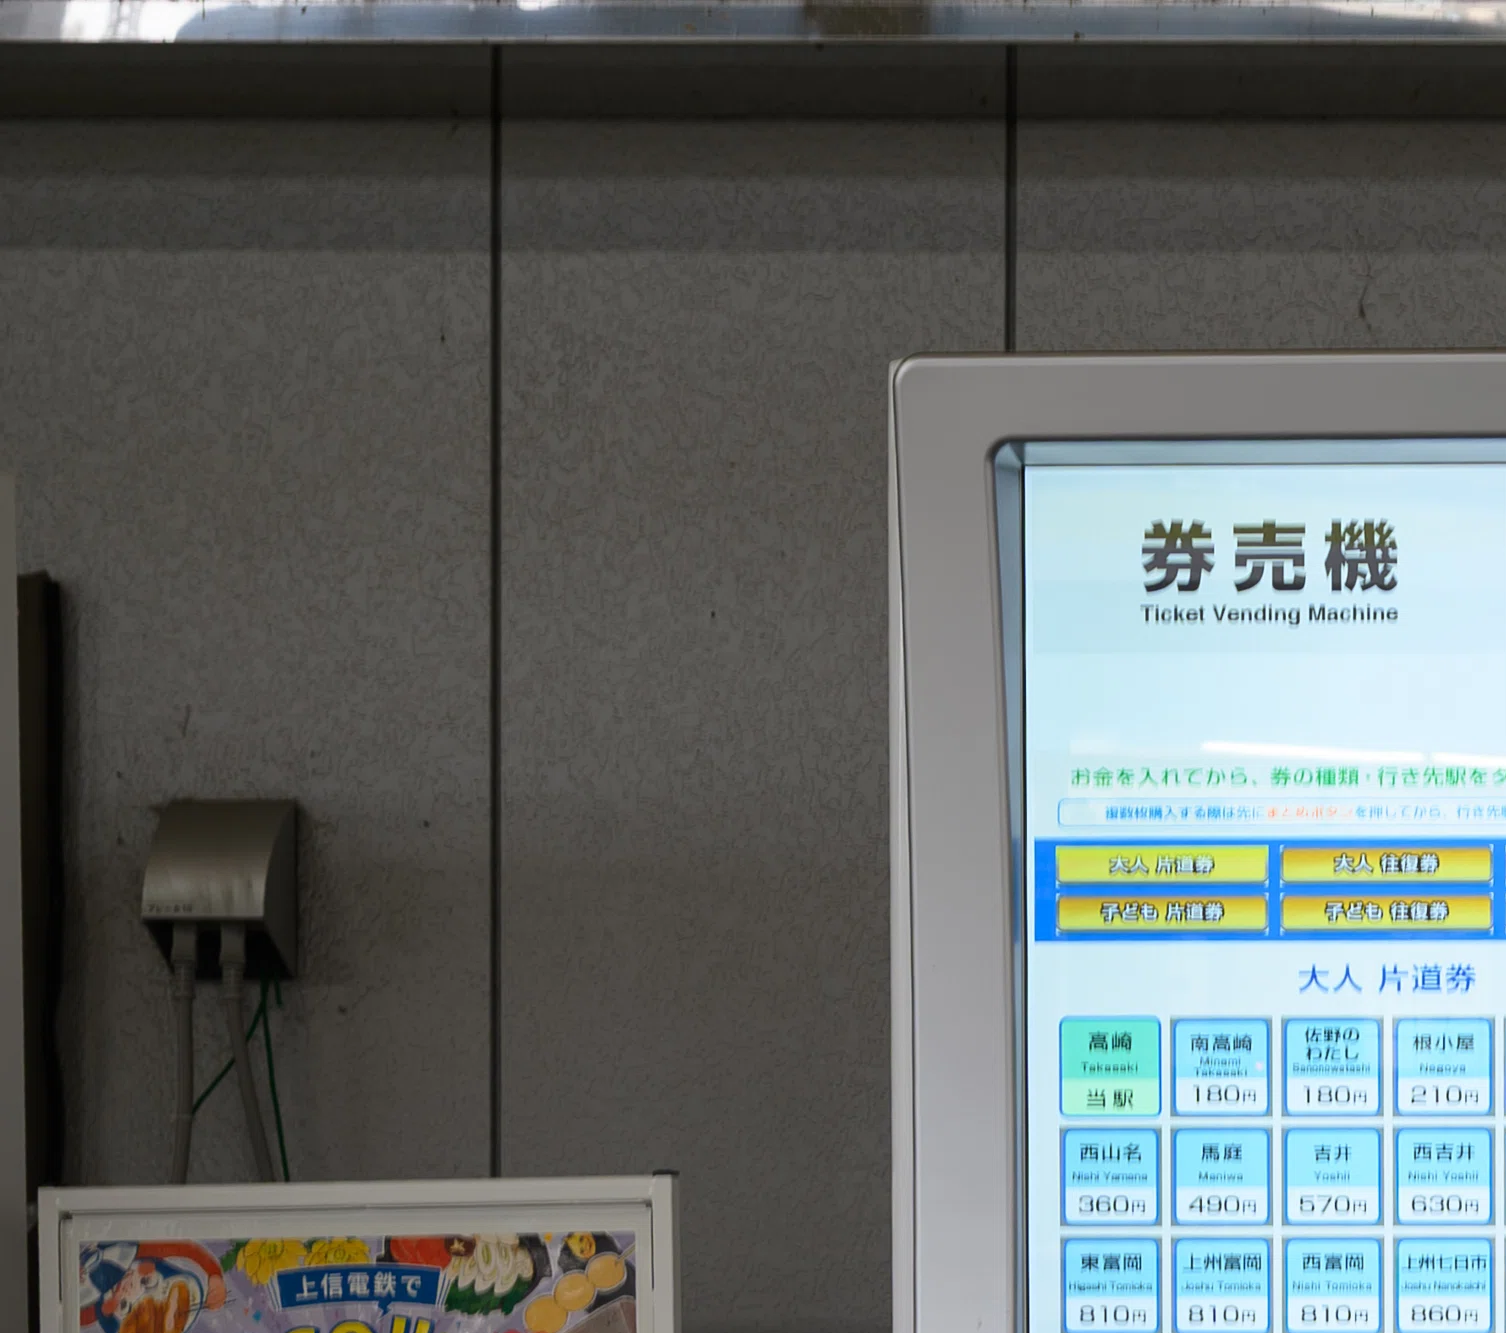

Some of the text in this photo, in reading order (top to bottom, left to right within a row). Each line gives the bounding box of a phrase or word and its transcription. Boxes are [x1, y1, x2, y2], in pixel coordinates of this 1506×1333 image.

[1141, 518, 1399, 593] 券売機
[1140, 604, 1399, 628] Ticket Vending Machine
[1109, 855, 1215, 875] 大人 片道券
[1334, 854, 1440, 875] 大人 往復券
[1100, 902, 1225, 923] 子ども 片道券
[1325, 902, 1449, 923] 子ども 往復券
[1299, 963, 1477, 994] 大人 片道券
[1088, 1030, 1133, 1053] 高崎
[1190, 1032, 1252, 1053] 南高崎
[1305, 1026, 1360, 1044] 佐野の
[1413, 1032, 1475, 1052] 根小屋
[1305, 1044, 1359, 1061] わたし
[1086, 1088, 1134, 1110] 当駅
[1193, 1084, 1257, 1105] 180円
[1304, 1084, 1367, 1105] 180円
[1411, 1084, 1479, 1105] 210円
[1080, 1142, 1143, 1163] 西山名
[1201, 1142, 1243, 1163] 馬庭
[1314, 1143, 1352, 1163] 吉井
[1413, 1142, 1476, 1162] 西吉井
[1079, 1194, 1146, 1215] 360円
[1188, 1194, 1257, 1215] 490円
[1299, 1194, 1367, 1215] 570円
[1411, 1194, 1479, 1215] 630円
[1081, 1252, 1142, 1272] 東富岡
[1183, 1252, 1262, 1273] 上州富岡
[1302, 1252, 1365, 1272] 西富岡
[1402, 1254, 1487, 1273] 上州七日市
[294, 1270, 423, 1302] 上信電鉄で
[1080, 1303, 1147, 1324] 810円
[1188, 1303, 1256, 1324] 810円
[1301, 1303, 1369, 1324] 810円
[1411, 1303, 1479, 1324] 860円
